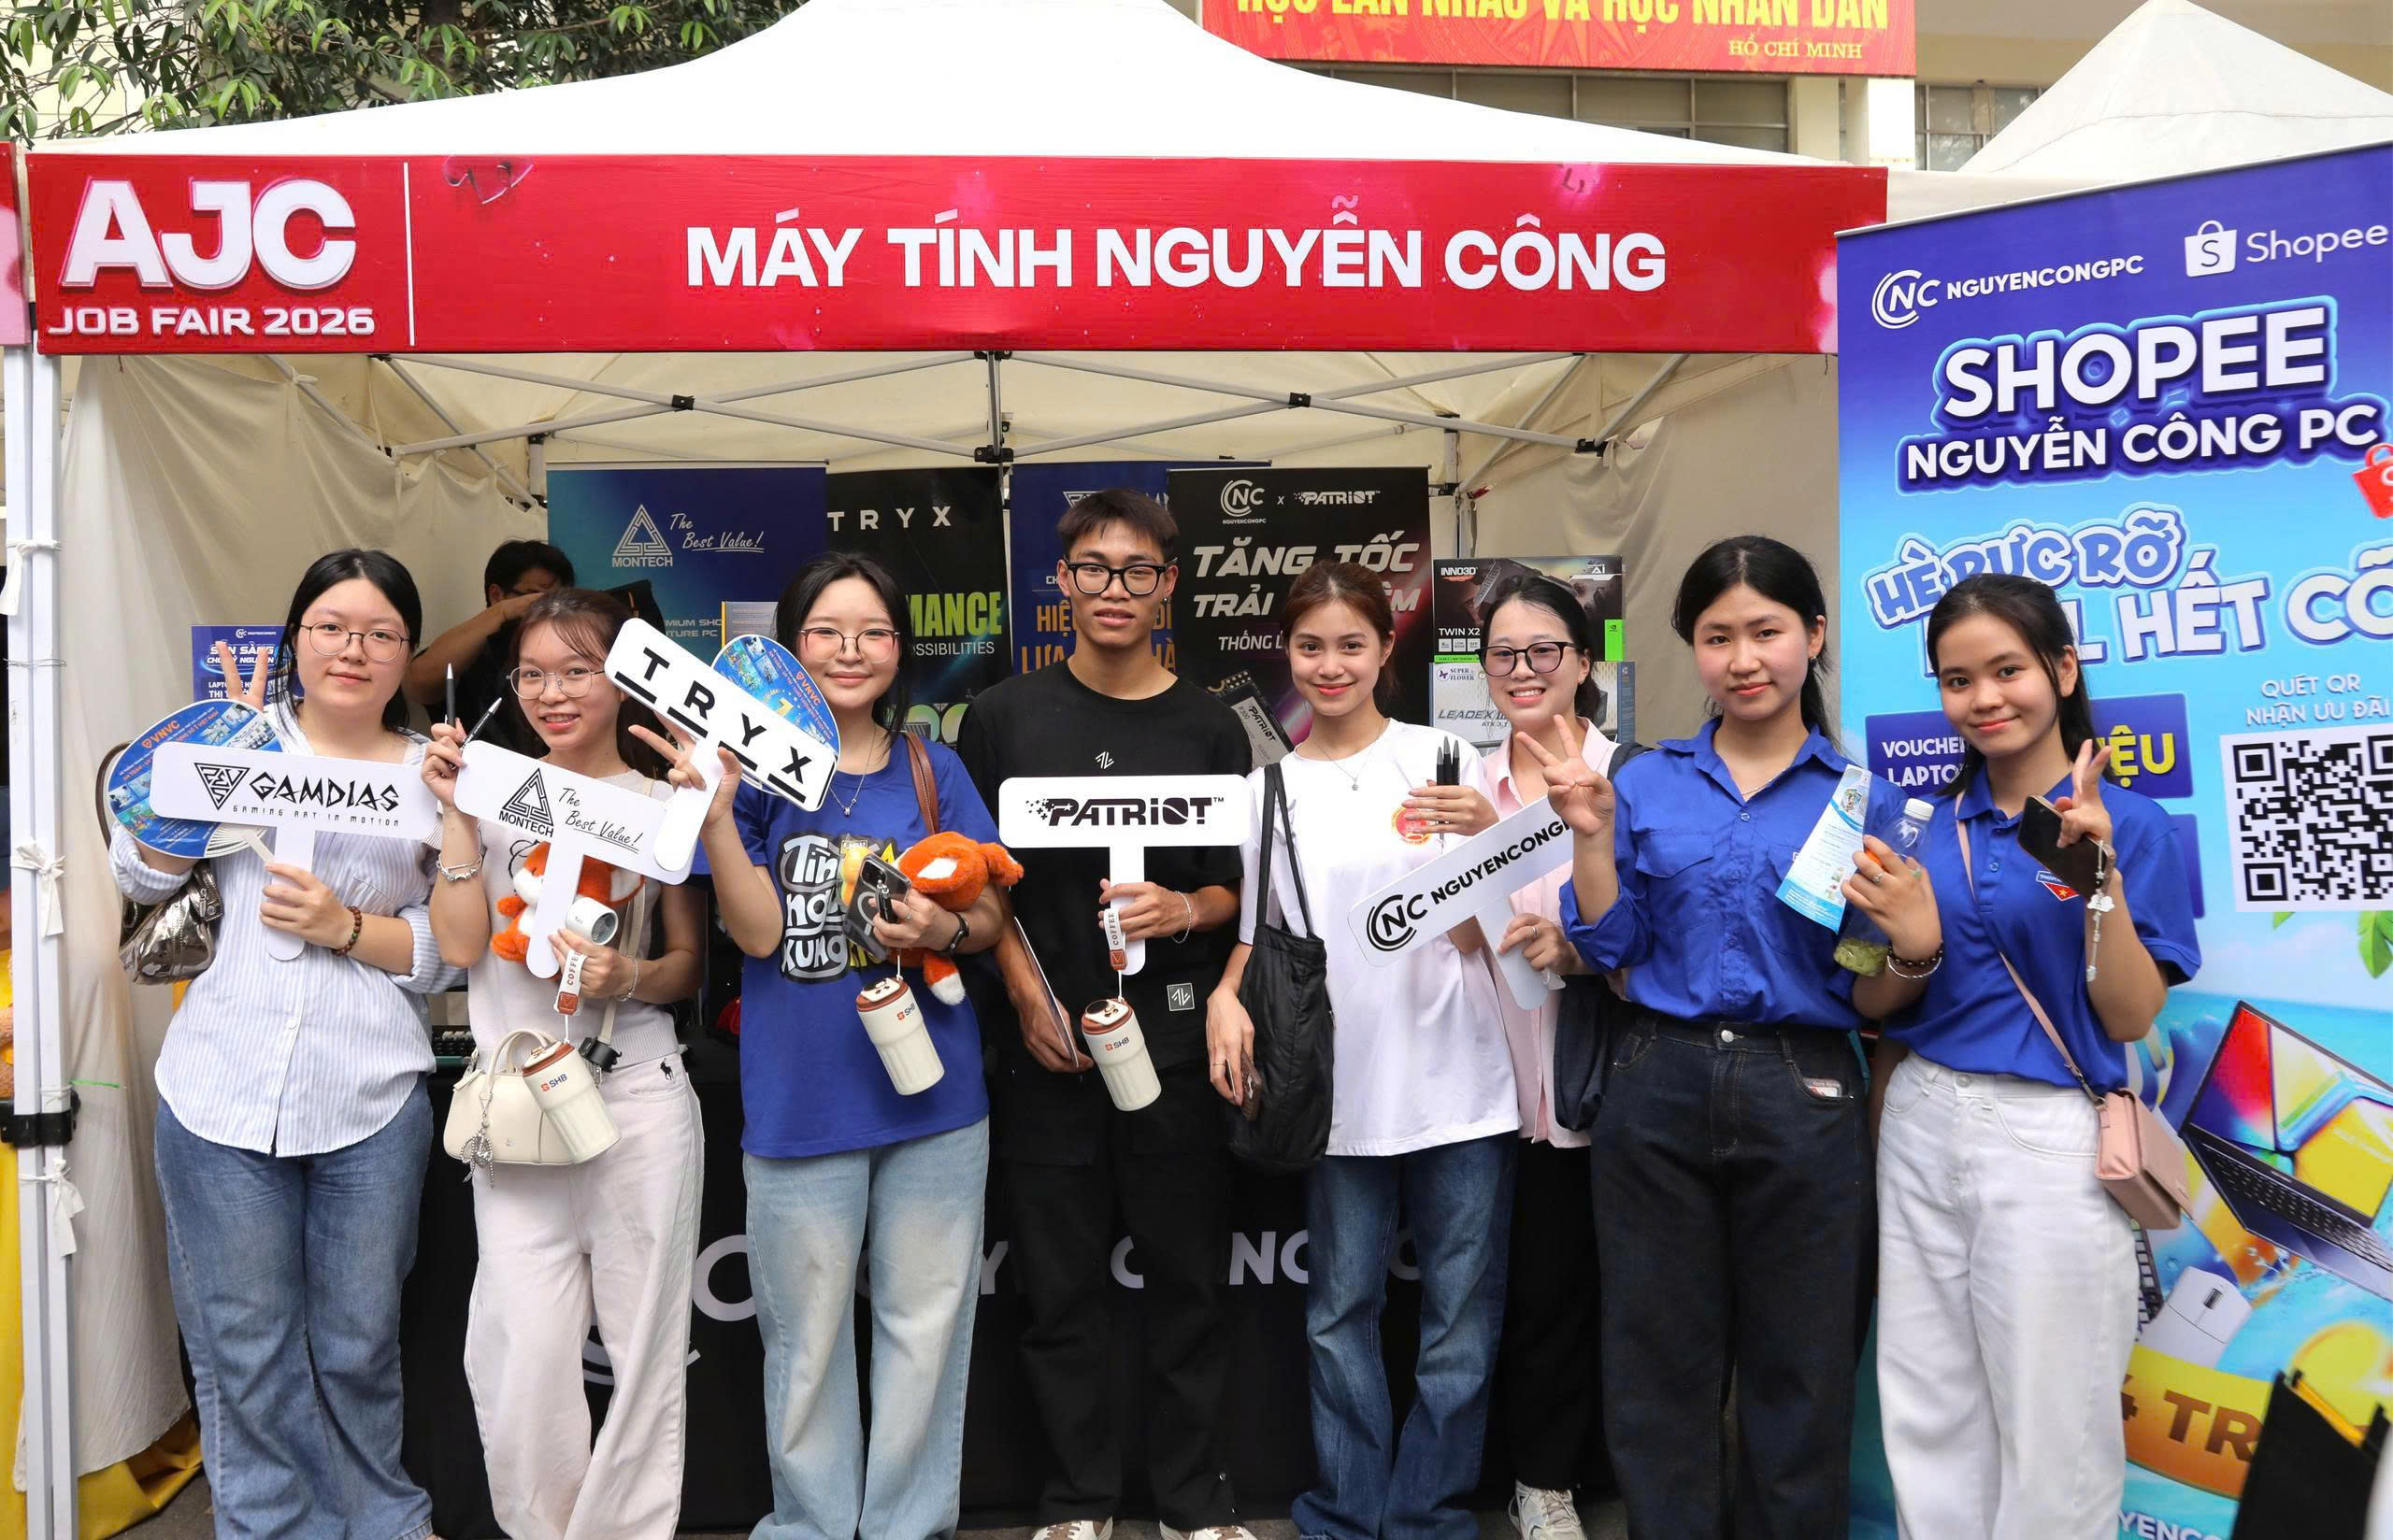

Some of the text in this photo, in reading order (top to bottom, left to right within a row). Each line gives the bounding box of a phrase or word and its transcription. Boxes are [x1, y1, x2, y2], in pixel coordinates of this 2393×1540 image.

[1728, 33, 1863, 59] HỒ CHÍ MINH
[58, 176, 357, 291] AJC
[687, 193, 1666, 292] MÁY TÍNH NGUYỄN CÔNG
[2244, 223, 2389, 264] Shopee
[1946, 254, 2144, 300] NGUYENCONGPC
[48, 307, 375, 335] JOB FAIR 2026
[1942, 306, 2326, 418] SHOPEE
[1907, 404, 2379, 479] NGUYỄN CÔNG PC
[668, 512, 694, 531] The
[826, 506, 952, 532] TRYX
[681, 530, 765, 549] Best Value!
[611, 556, 674, 568] MONTECH
[1193, 530, 1420, 578] TĂNG TỐC
[1870, 538, 1943, 627] HÈ
[2079, 509, 2184, 587] RỠ
[1193, 583, 1274, 618] TRẢI
[2116, 549, 2269, 662] HẾT
[701, 629, 718, 637] PC
[1218, 629, 1273, 651] THỐNG
[1438, 627, 1481, 636] TWIN X2
[912, 641, 996, 656] SSIBILITIES
[801, 678, 821, 706] VNVC
[2260, 673, 2361, 699] QUÉT QR
[1438, 709, 1496, 720] LEADEX
[2245, 702, 2307, 728] NHẬN
[2353, 695, 2391, 720] ĐÃI
[150, 719, 180, 744] VNVC
[1887, 763, 1964, 788] LAPTO
[249, 770, 400, 812] GAMDIAS
[558, 787, 580, 807] The
[233, 805, 284, 817] GAMING
[350, 815, 399, 827] MOTION
[497, 810, 554, 838] MONTECH
[565, 810, 643, 846] Best Value!
[1430, 818, 1572, 905] NGUYENCONG
[1108, 912, 1119, 946] COFFEE
[1112, 1036, 1130, 1048] SHB
[549, 1073, 568, 1089] SHB
